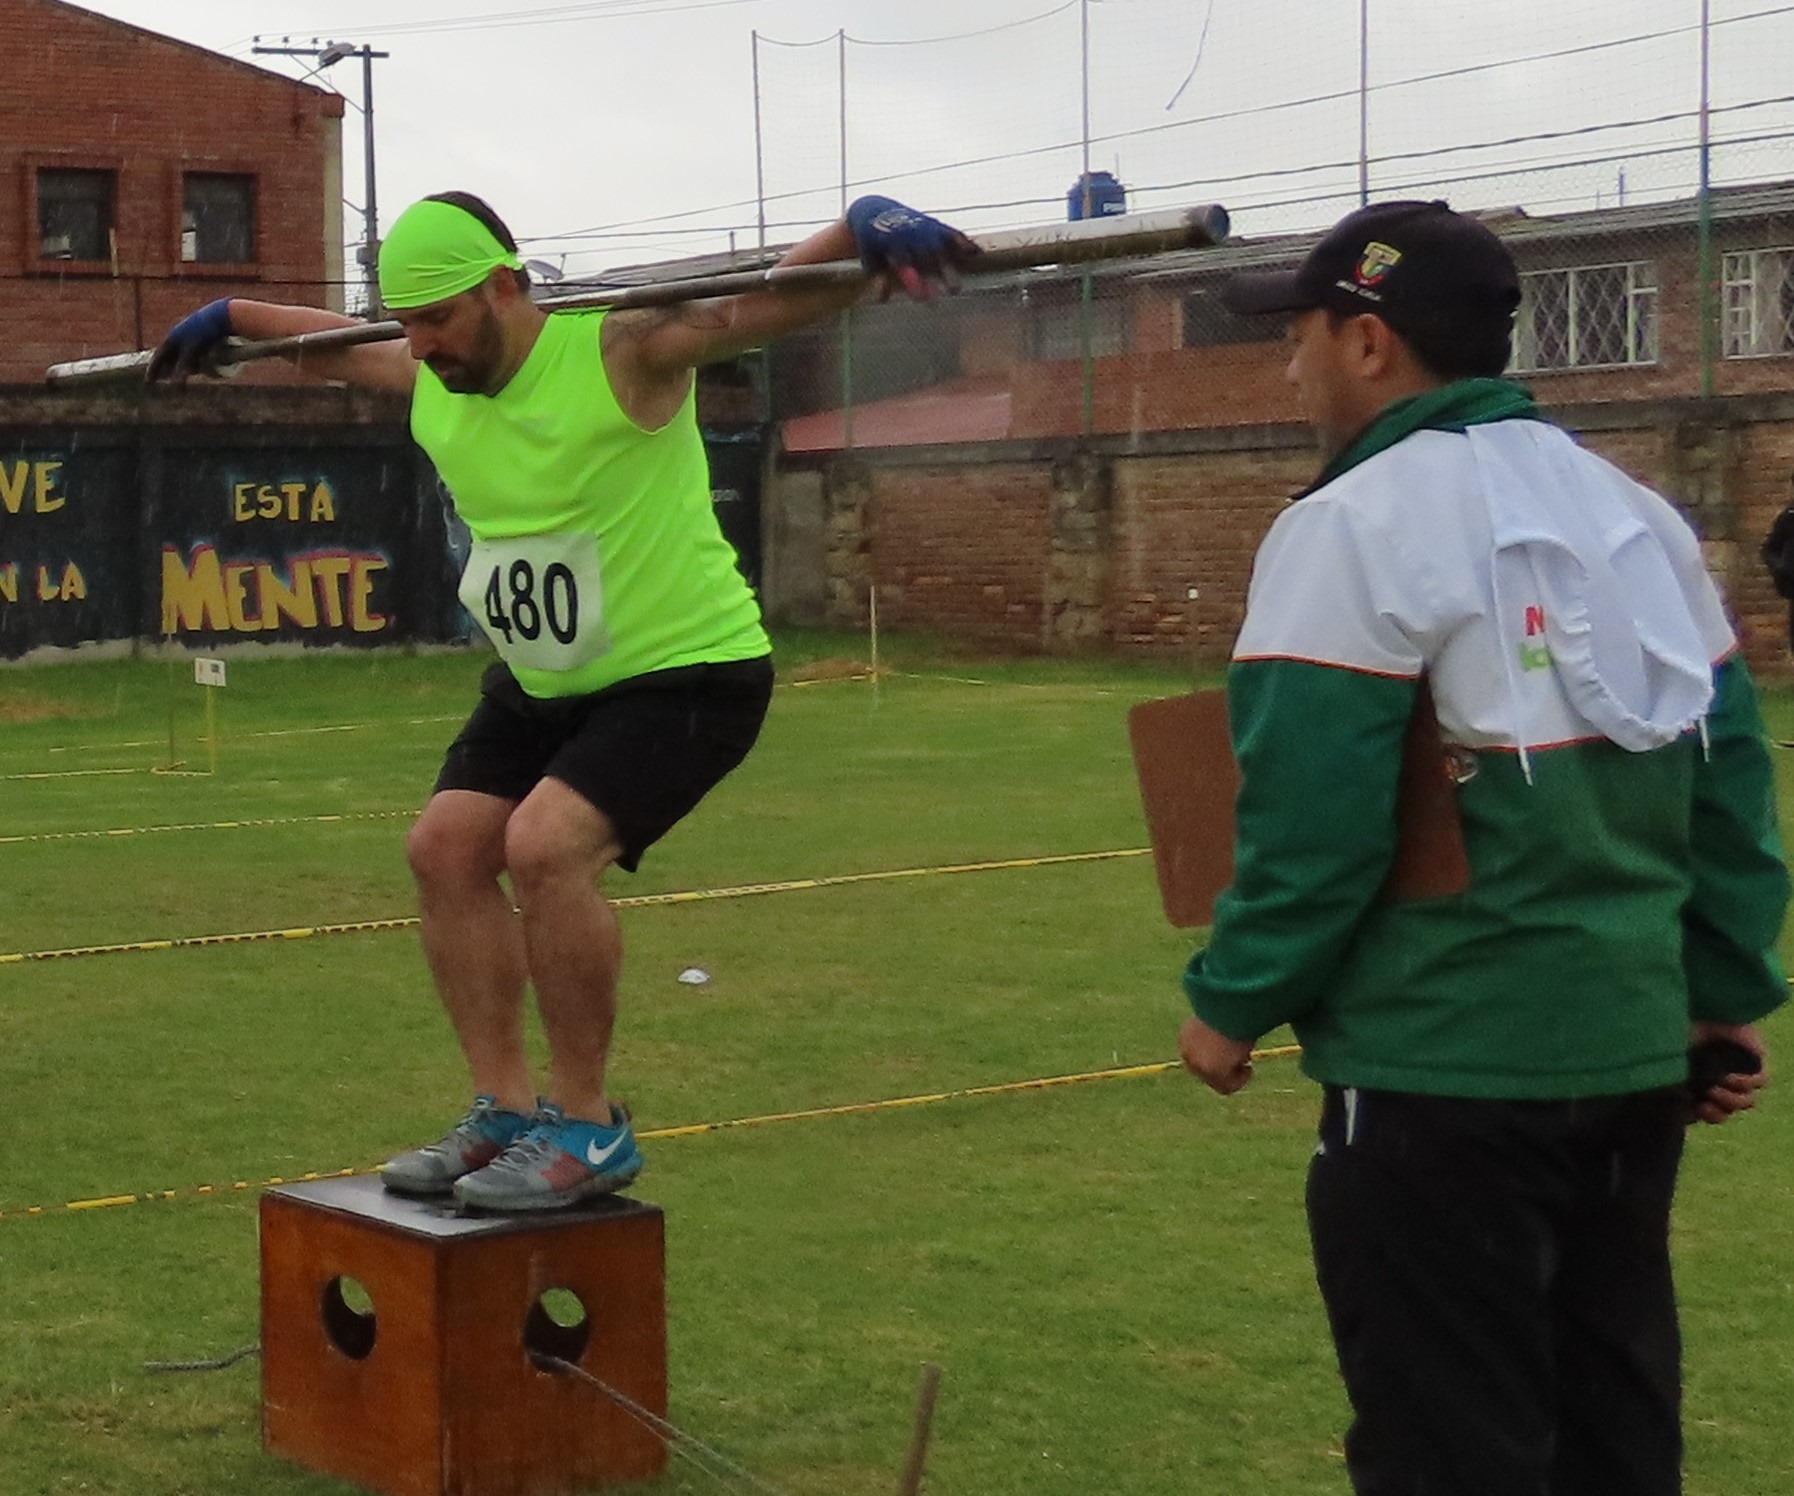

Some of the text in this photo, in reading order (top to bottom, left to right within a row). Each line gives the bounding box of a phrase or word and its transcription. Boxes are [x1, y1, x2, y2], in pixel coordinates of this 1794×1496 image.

[235, 482, 335, 522] ESTA
[38, 562, 87, 602] LA
[161, 545, 389, 634] MENTE
[485, 559, 578, 644] 480
